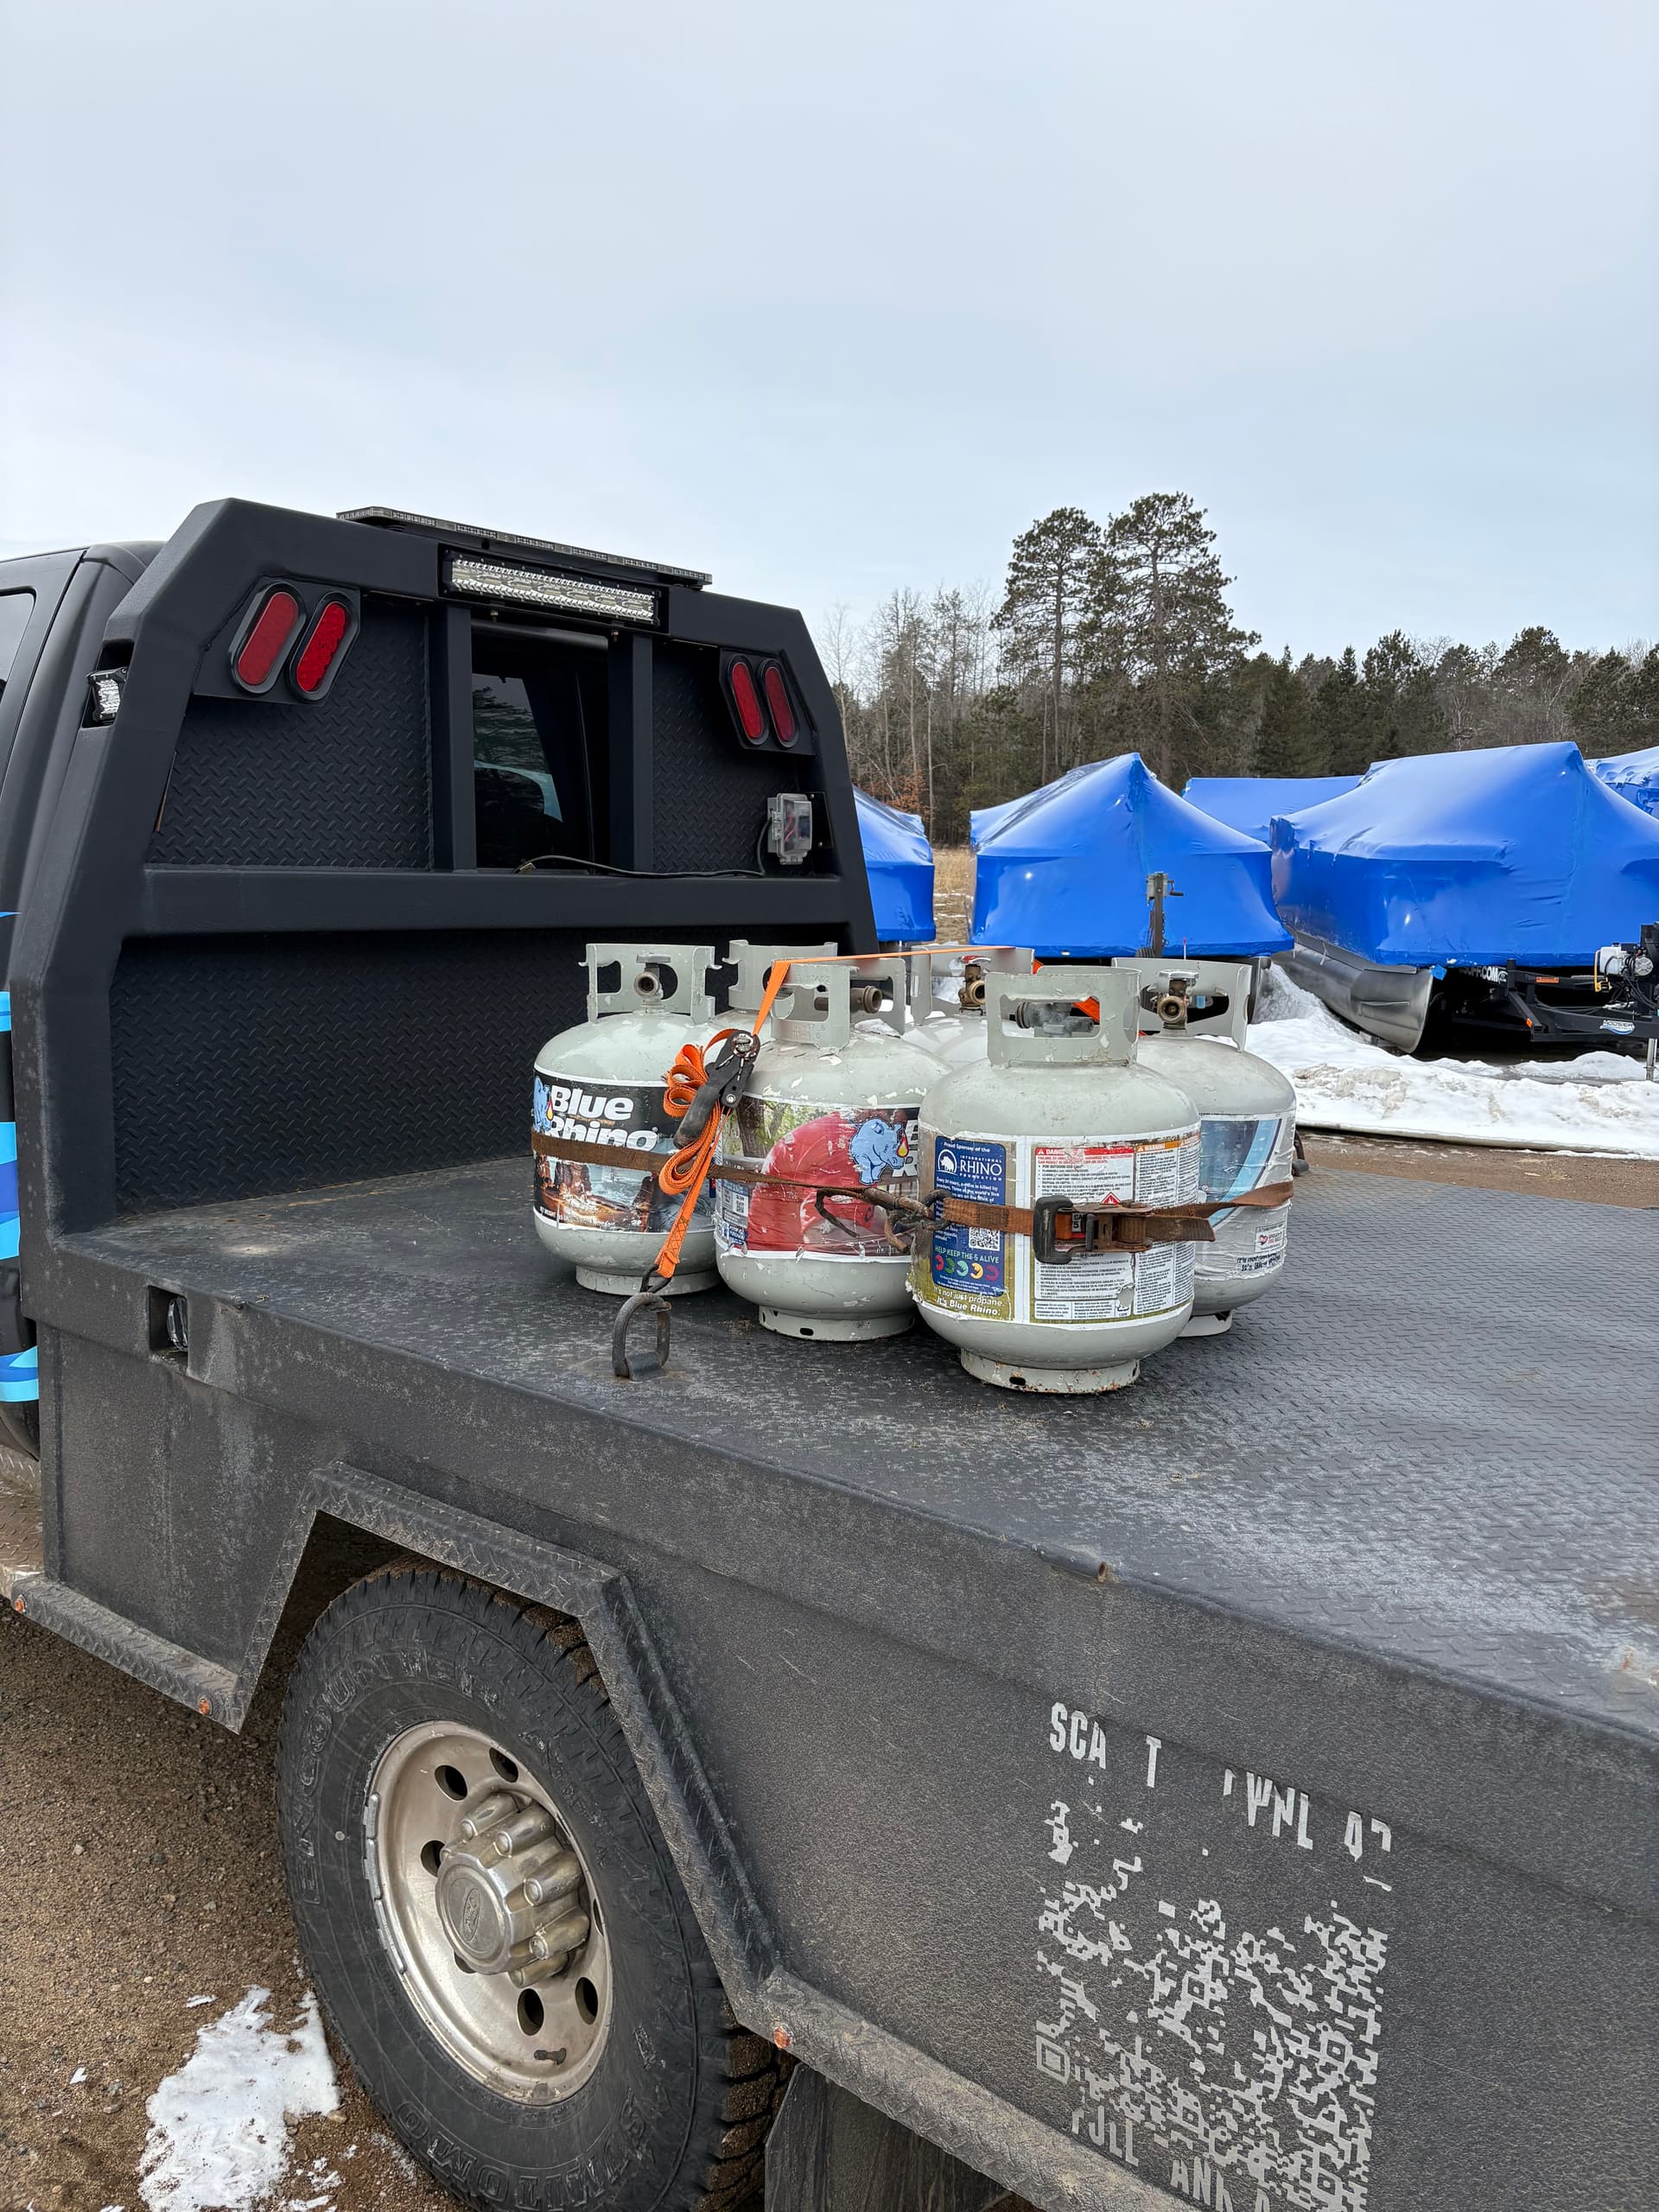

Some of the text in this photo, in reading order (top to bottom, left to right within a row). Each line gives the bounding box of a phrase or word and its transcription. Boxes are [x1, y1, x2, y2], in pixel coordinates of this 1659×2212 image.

[550, 1084, 634, 1121] Blue
[545, 1116, 657, 1152] Rhino
[960, 1154, 1002, 1163] INTERNATIONAL
[960, 1159, 1002, 1176] RHINO
[959, 1173, 1002, 1181] FOUNDATION
[935, 1245, 946, 1254] HELP
[947, 1249, 960, 1257] KEEP
[979, 1255, 1000, 1263] ALIVE
[937, 1296, 947, 1307] It's
[950, 1300, 968, 1310] Blue
[969, 1296, 1004, 1306] propane.
